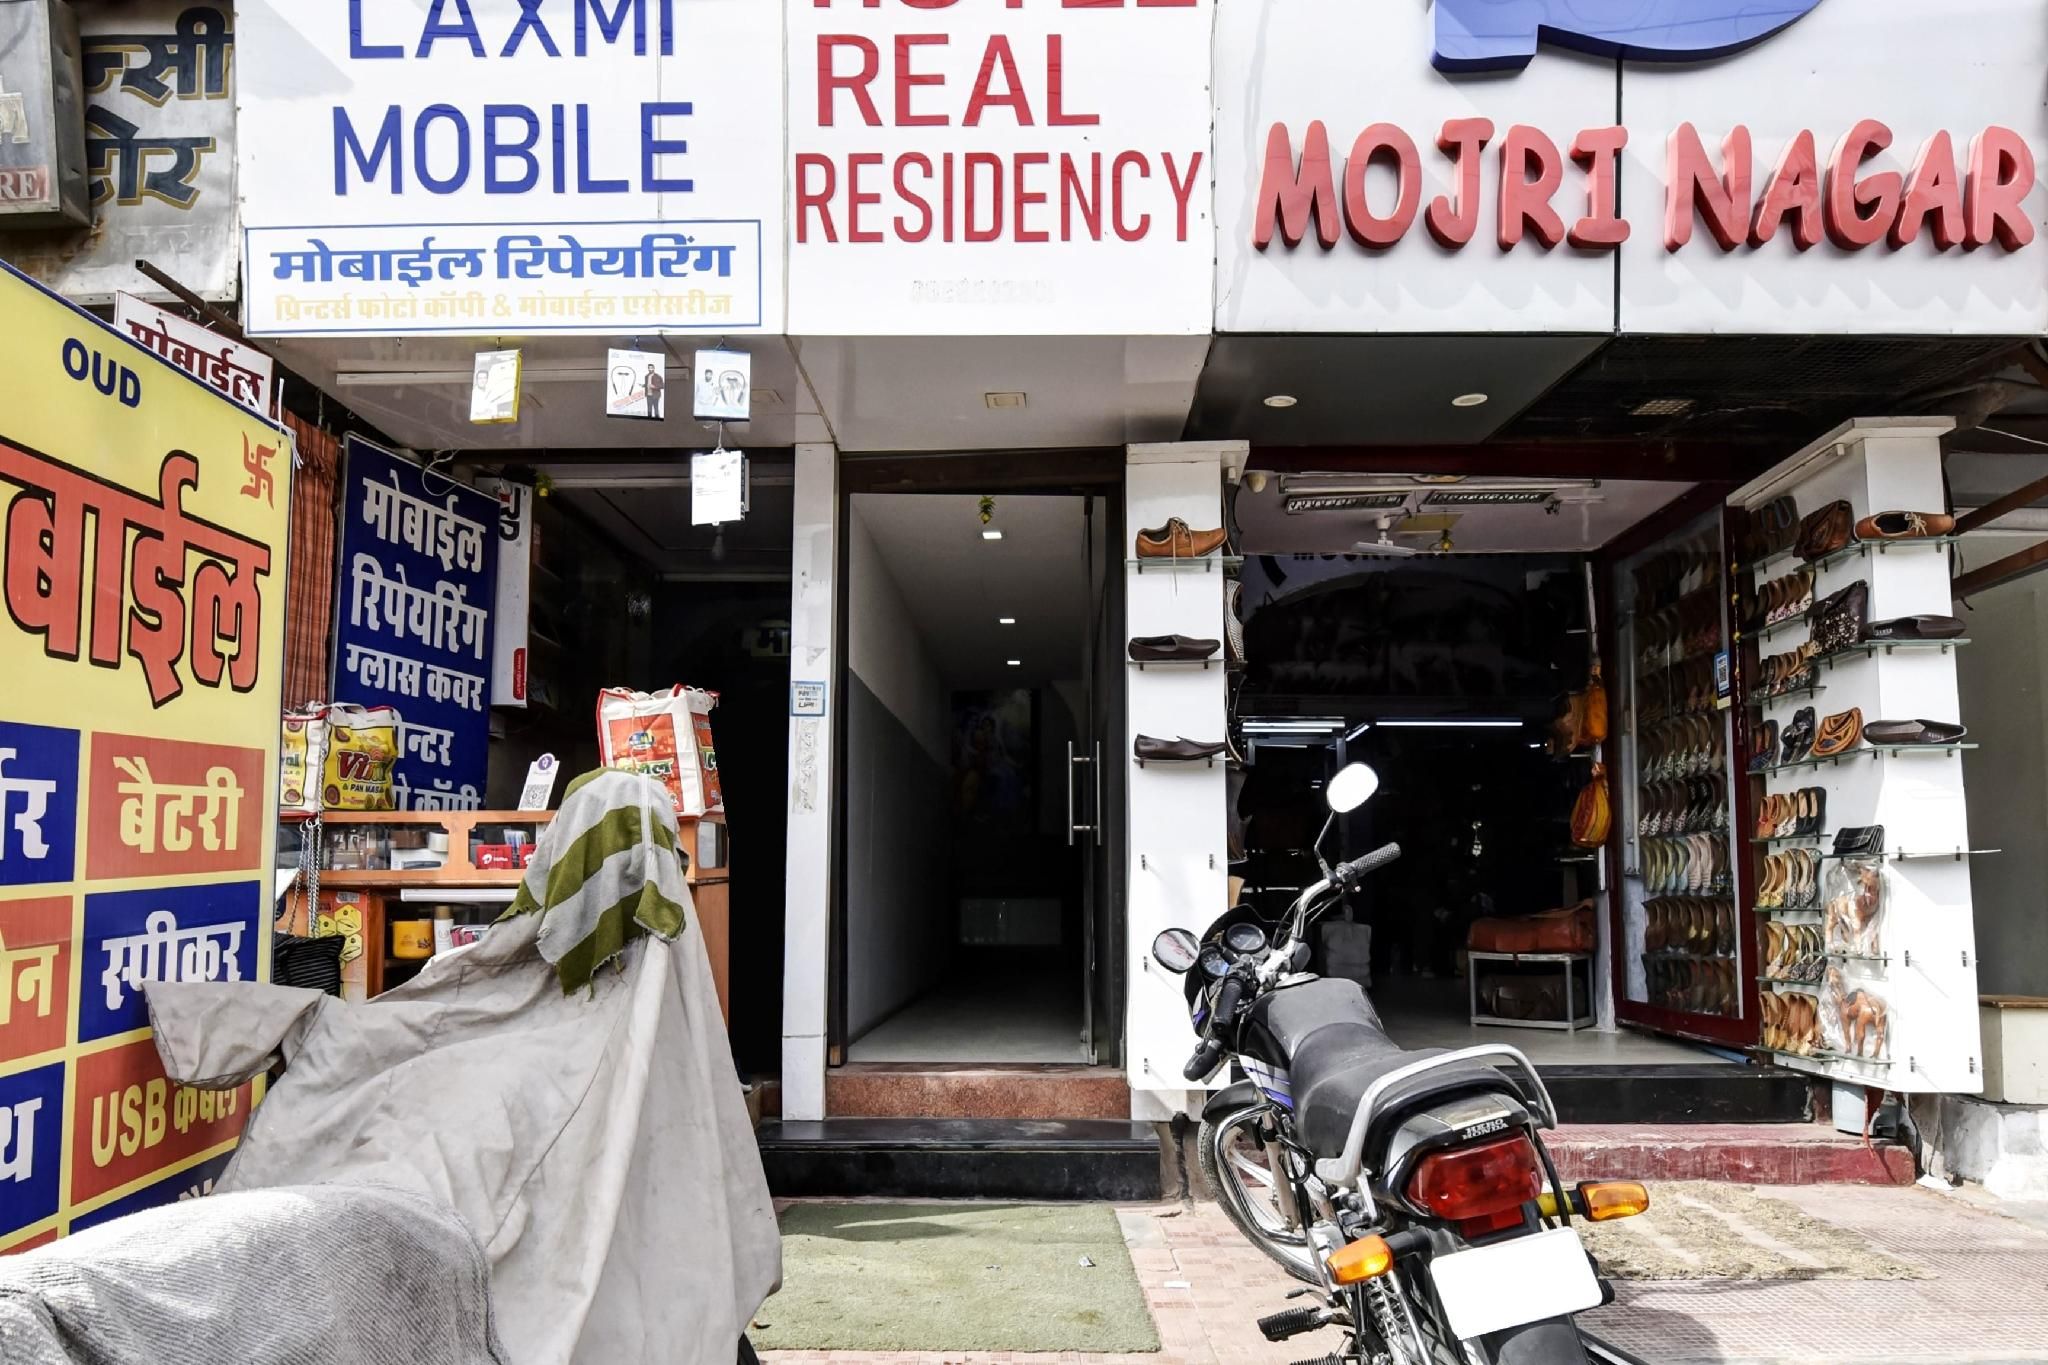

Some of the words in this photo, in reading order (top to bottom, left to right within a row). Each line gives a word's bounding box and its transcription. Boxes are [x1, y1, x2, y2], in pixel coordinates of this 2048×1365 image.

[349, 0, 674, 58] LAXMI
[816, 33, 1101, 127] REAL
[333, 102, 694, 195] MOBILE
[1252, 117, 1631, 251] MOJRI
[1663, 118, 2035, 253] NAGAR
[795, 150, 1204, 243] RESIDENCY
[270, 236, 486, 287] मोबाईल
[495, 233, 736, 279] रिपेयरिंग
[62, 337, 142, 408] OUD
[362, 469, 486, 574] मोबाईल
[351, 552, 487, 661] रिपेयरिंग
[346, 642, 422, 699] ग्लास
[426, 667, 485, 713] कवर
[112, 755, 245, 855] बैटरी
[91, 1077, 167, 1168] USB
